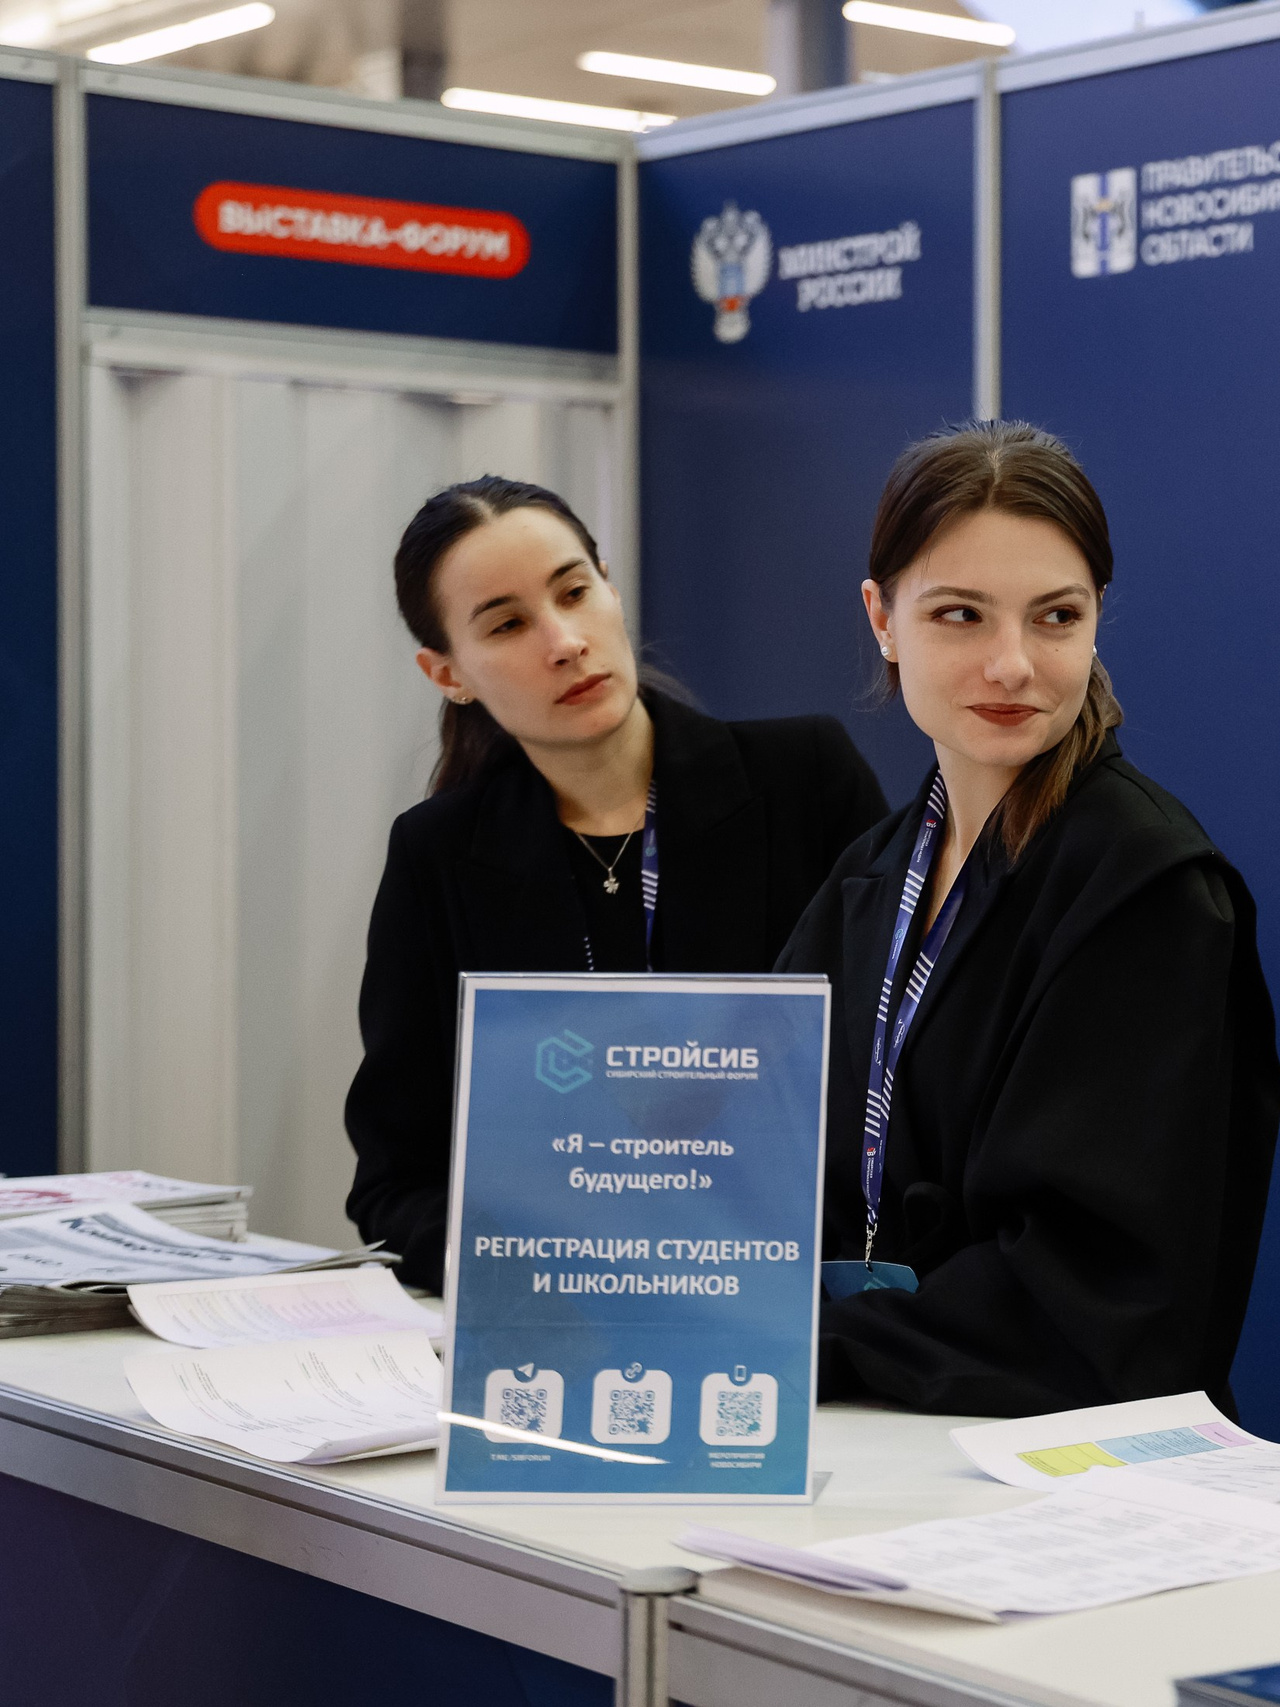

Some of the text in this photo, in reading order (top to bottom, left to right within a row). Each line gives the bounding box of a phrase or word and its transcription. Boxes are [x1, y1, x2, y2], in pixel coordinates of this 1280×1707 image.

[218, 199, 510, 262] ВЫСТАВКА-ФОРУМ
[1141, 222, 1254, 266] ОБЛАСТИ
[778, 220, 922, 280] МИНСТРОЙ
[797, 266, 903, 313] РОССИИ
[606, 1040, 760, 1068] СТРОЙСИБ
[552, 1133, 583, 1153] «Я
[610, 1138, 735, 1159] строитель
[568, 1167, 713, 1194] будущего!»
[475, 1237, 800, 1264] РЕГИСТРАЦИЯ СТУДЕНТОВ
[533, 1272, 740, 1295] И ШКОЛЬНИКОВ
